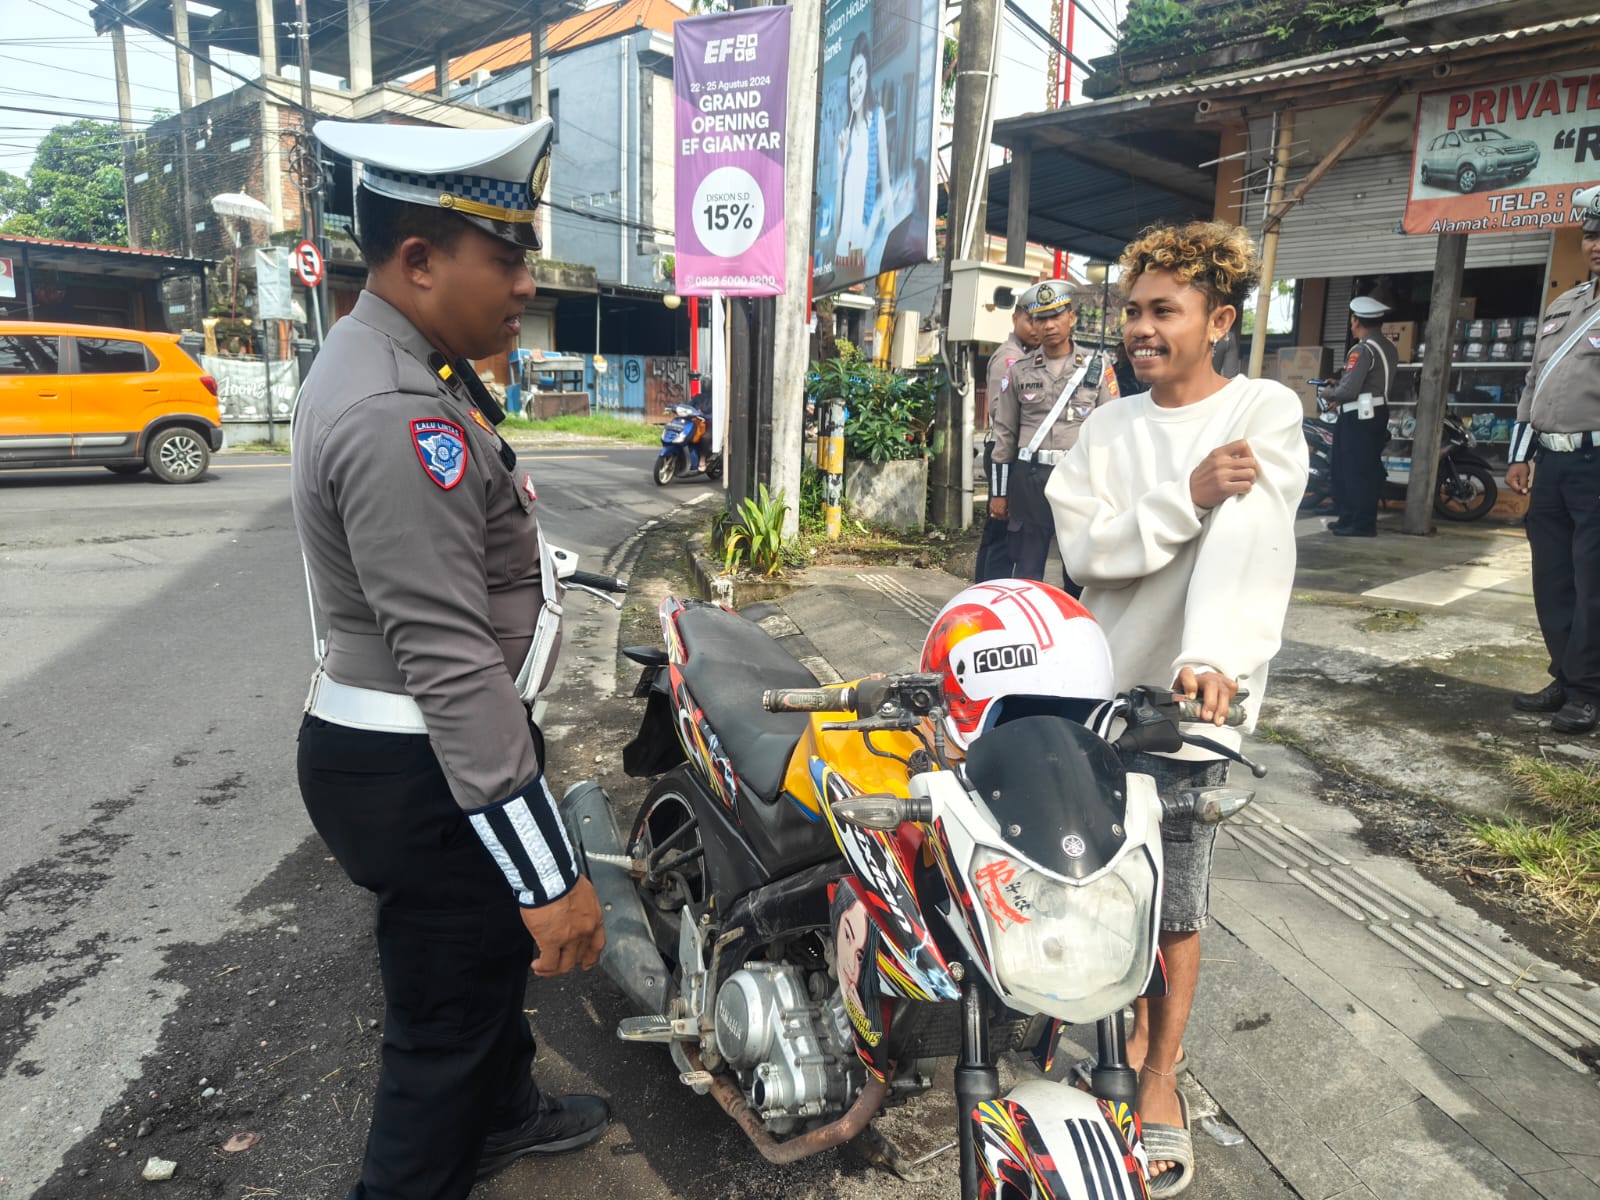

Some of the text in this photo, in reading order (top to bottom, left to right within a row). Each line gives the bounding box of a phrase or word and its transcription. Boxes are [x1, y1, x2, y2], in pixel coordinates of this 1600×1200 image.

[704, 39, 735, 64] EF
[690, 83, 702, 92] 22
[706, 81, 717, 91] 25
[718, 79, 748, 90] Agustus
[749, 76, 771, 87] 2024
[699, 90, 762, 112] GRAND
[691, 111, 769, 134] OPENING
[682, 132, 781, 156] EF GIANYAR
[706, 193, 736, 203] DISKON
[703, 203, 753, 231] 15%
[1430, 217, 1489, 233] Alamat
[1501, 212, 1564, 229] Lampu
[416, 422, 459, 436] LALU LINTAS
[976, 645, 1036, 672] FOOM
